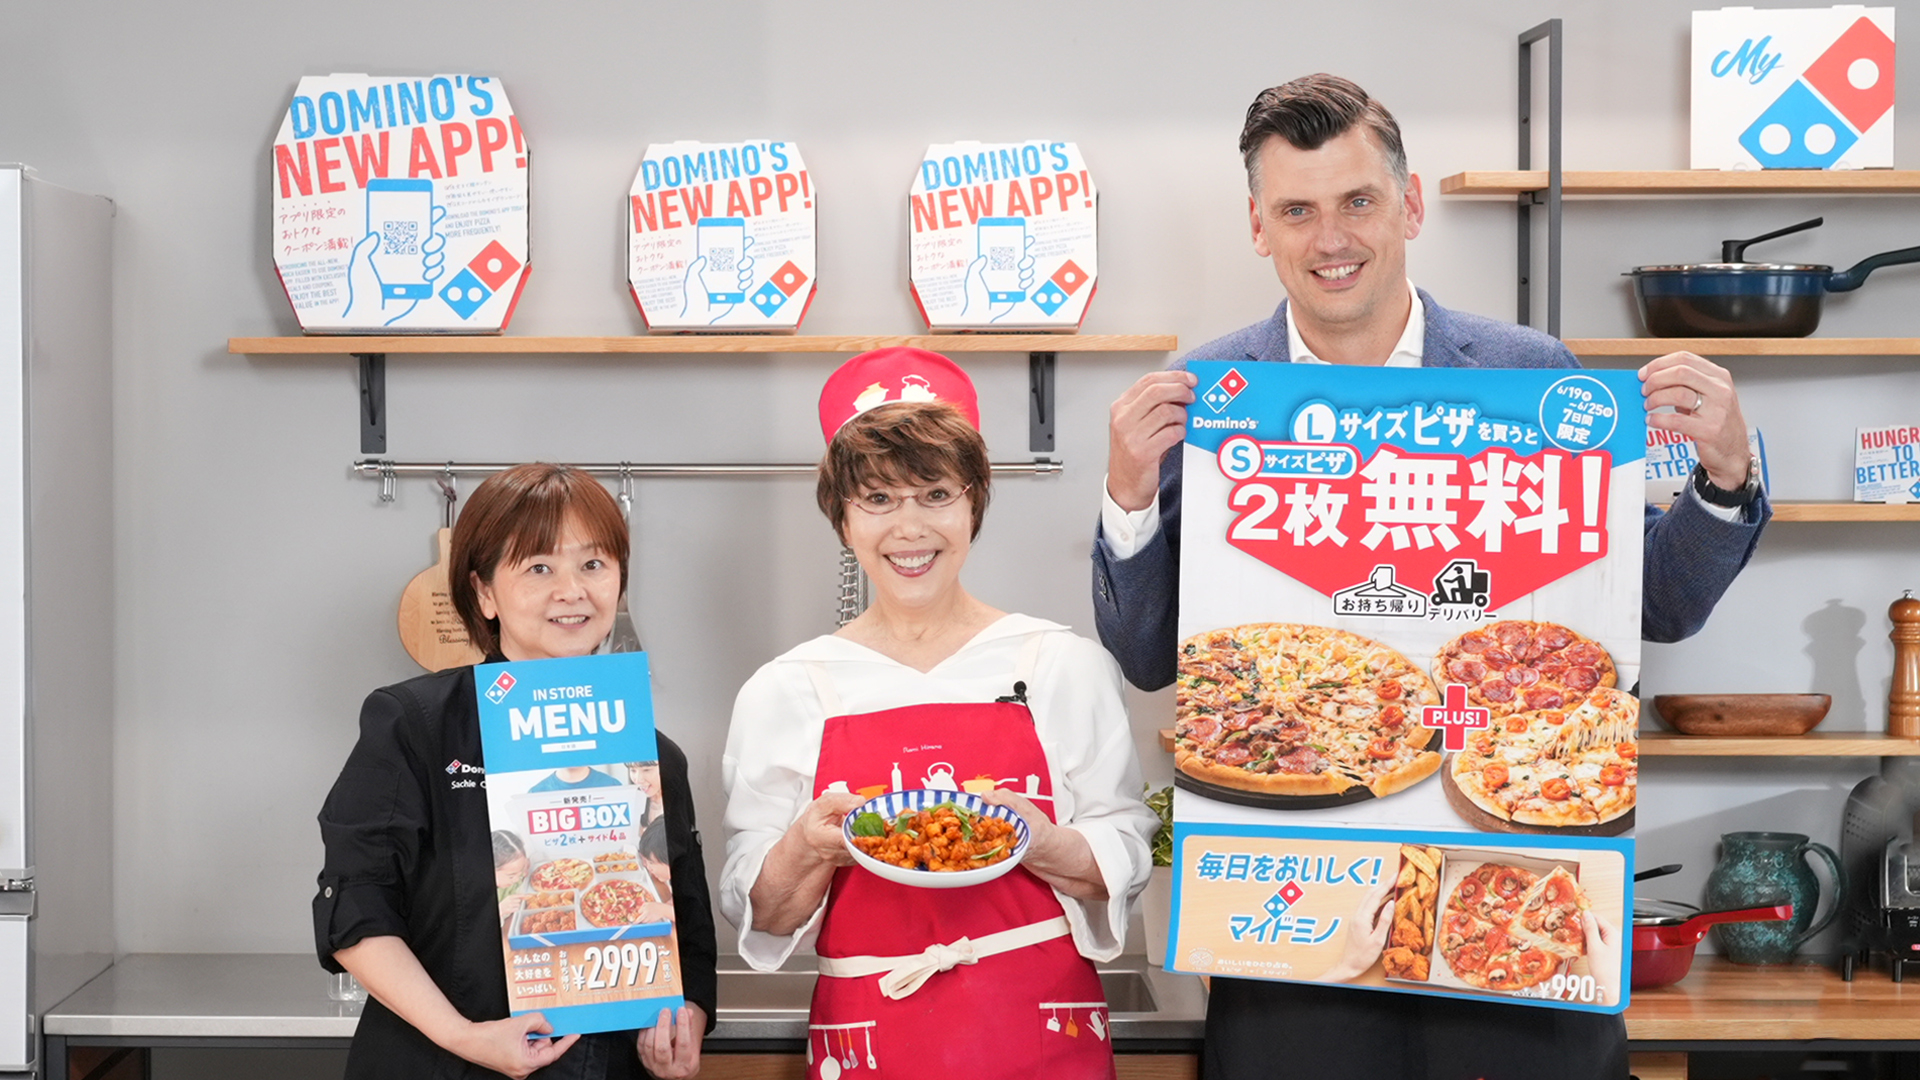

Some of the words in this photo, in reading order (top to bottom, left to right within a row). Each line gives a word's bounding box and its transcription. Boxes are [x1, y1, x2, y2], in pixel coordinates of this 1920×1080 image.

[1711, 35, 1784, 85] My
[289, 75, 494, 139] DOMINO'S
[275, 131, 390, 199] NEW
[408, 115, 527, 179] APP!
[641, 142, 789, 191] DOMINO'S
[921, 142, 1069, 191] DOMINO'S
[630, 184, 713, 234] NEW
[726, 170, 812, 218] APP!
[911, 184, 993, 233] NEW
[1007, 170, 1092, 217] APP!
[279, 207, 346, 224] アプリ限定の
[455, 220, 473, 228] ENJOY
[475, 218, 490, 226] PIZZA
[282, 226, 321, 239] おトクな
[445, 230, 461, 238] MORE
[311, 291, 321, 299] THE
[322, 288, 337, 297] BEST
[1193, 416, 1257, 430] Domino's
[1562, 408, 1593, 426] 7日間
[1556, 423, 1591, 445] 限定
[1230, 445, 1347, 474] Sサイズピザ
[1665, 443, 1689, 460] TO
[1892, 444, 1913, 462] TO
[1856, 460, 1920, 484] BETTER
[1342, 598, 1419, 613] お持ち帰り
[1428, 608, 1497, 622] デリバリー
[533, 689, 548, 701] IN
[549, 685, 593, 700] STORE
[508, 699, 627, 741] MENU
[1432, 710, 1480, 725] PLUS!
[451, 779, 476, 789] Sachie
[532, 808, 576, 833] BIG
[581, 804, 630, 829] BOX
[1197, 852, 1383, 885] 毎日をおいしく!
[1229, 916, 1342, 945] マイドミノ
[513, 952, 550, 964] みんなの
[515, 967, 551, 980] 大好きを
